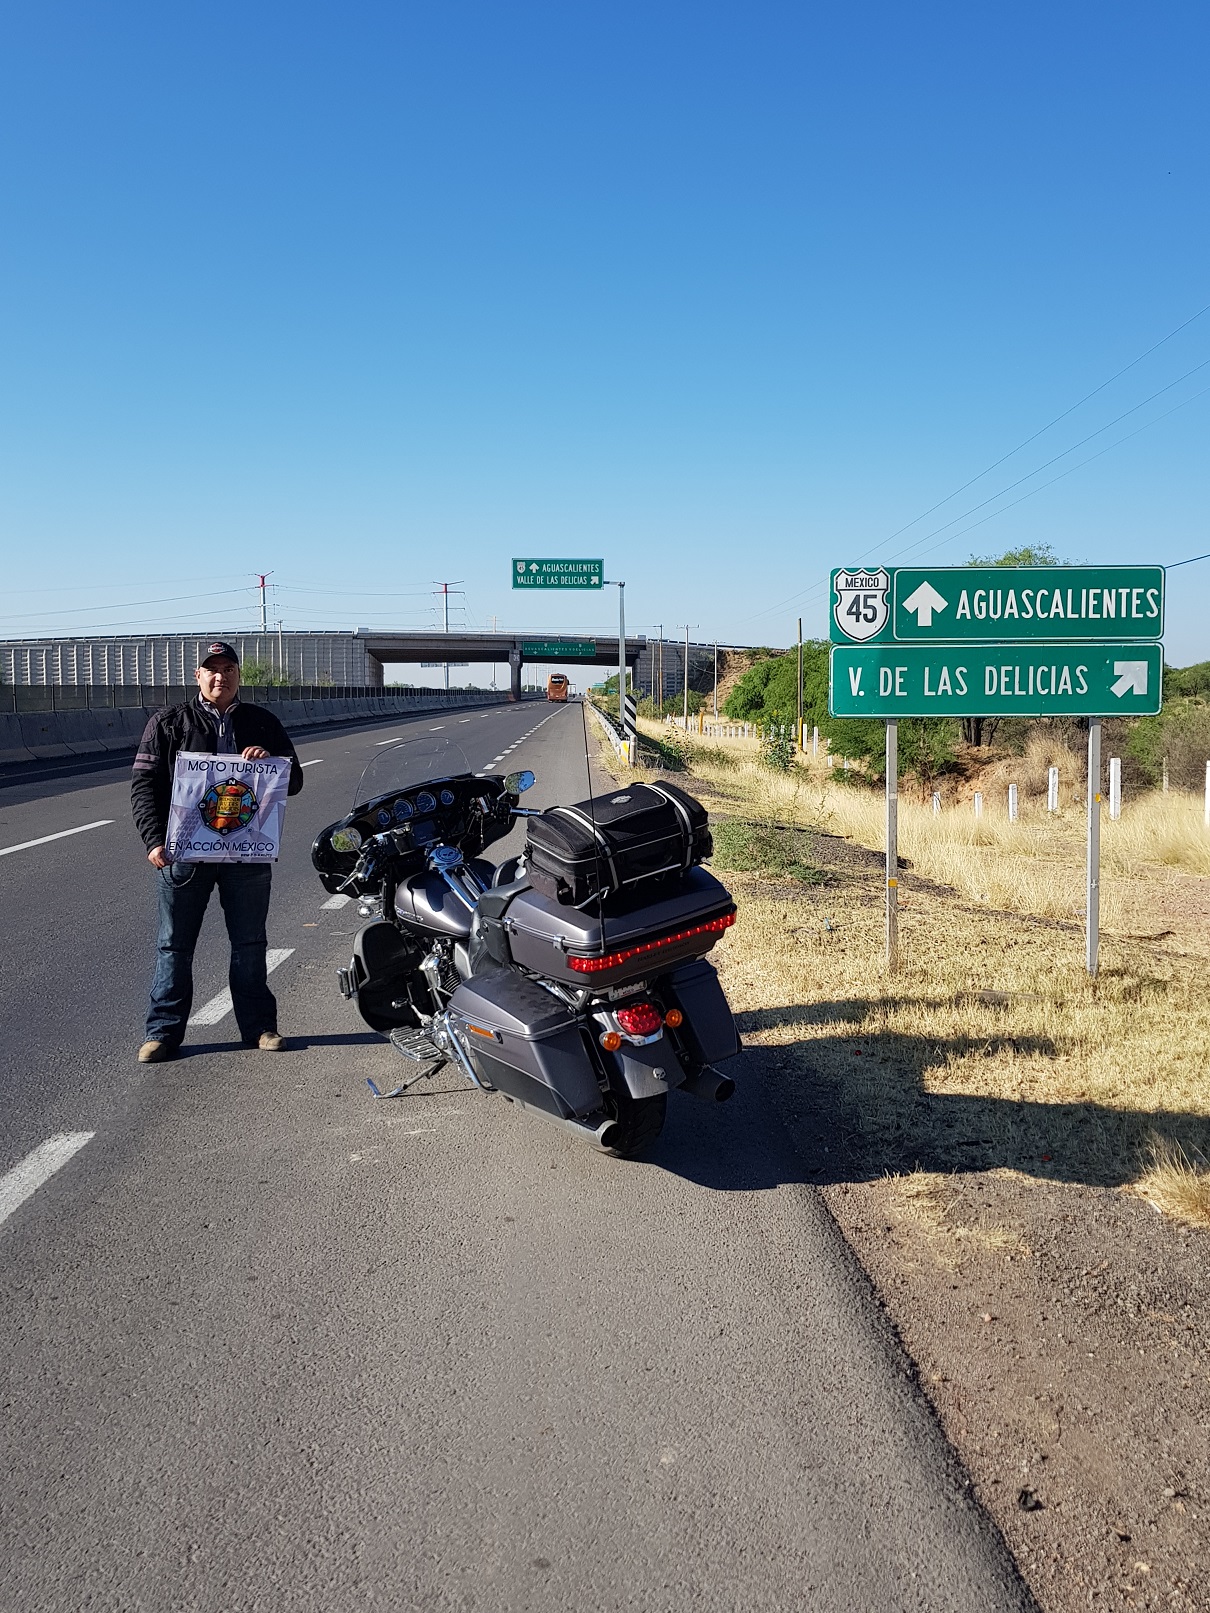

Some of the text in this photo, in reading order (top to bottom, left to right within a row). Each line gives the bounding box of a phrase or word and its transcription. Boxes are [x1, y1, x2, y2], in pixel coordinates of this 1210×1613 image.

[542, 564, 600, 572] AGUASCALIENTES
[516, 576, 587, 584] VALLE DE LAS DELICIAS
[845, 577, 879, 588] MEXICO
[846, 594, 877, 623] 45
[956, 588, 1160, 620] AGUASCALIENTES
[848, 665, 1088, 696] V. DE LAS DELICIAS
[188, 760, 278, 774] MOTO TURISTA
[169, 838, 274, 852] EN ACCIÓN MÉXICO
